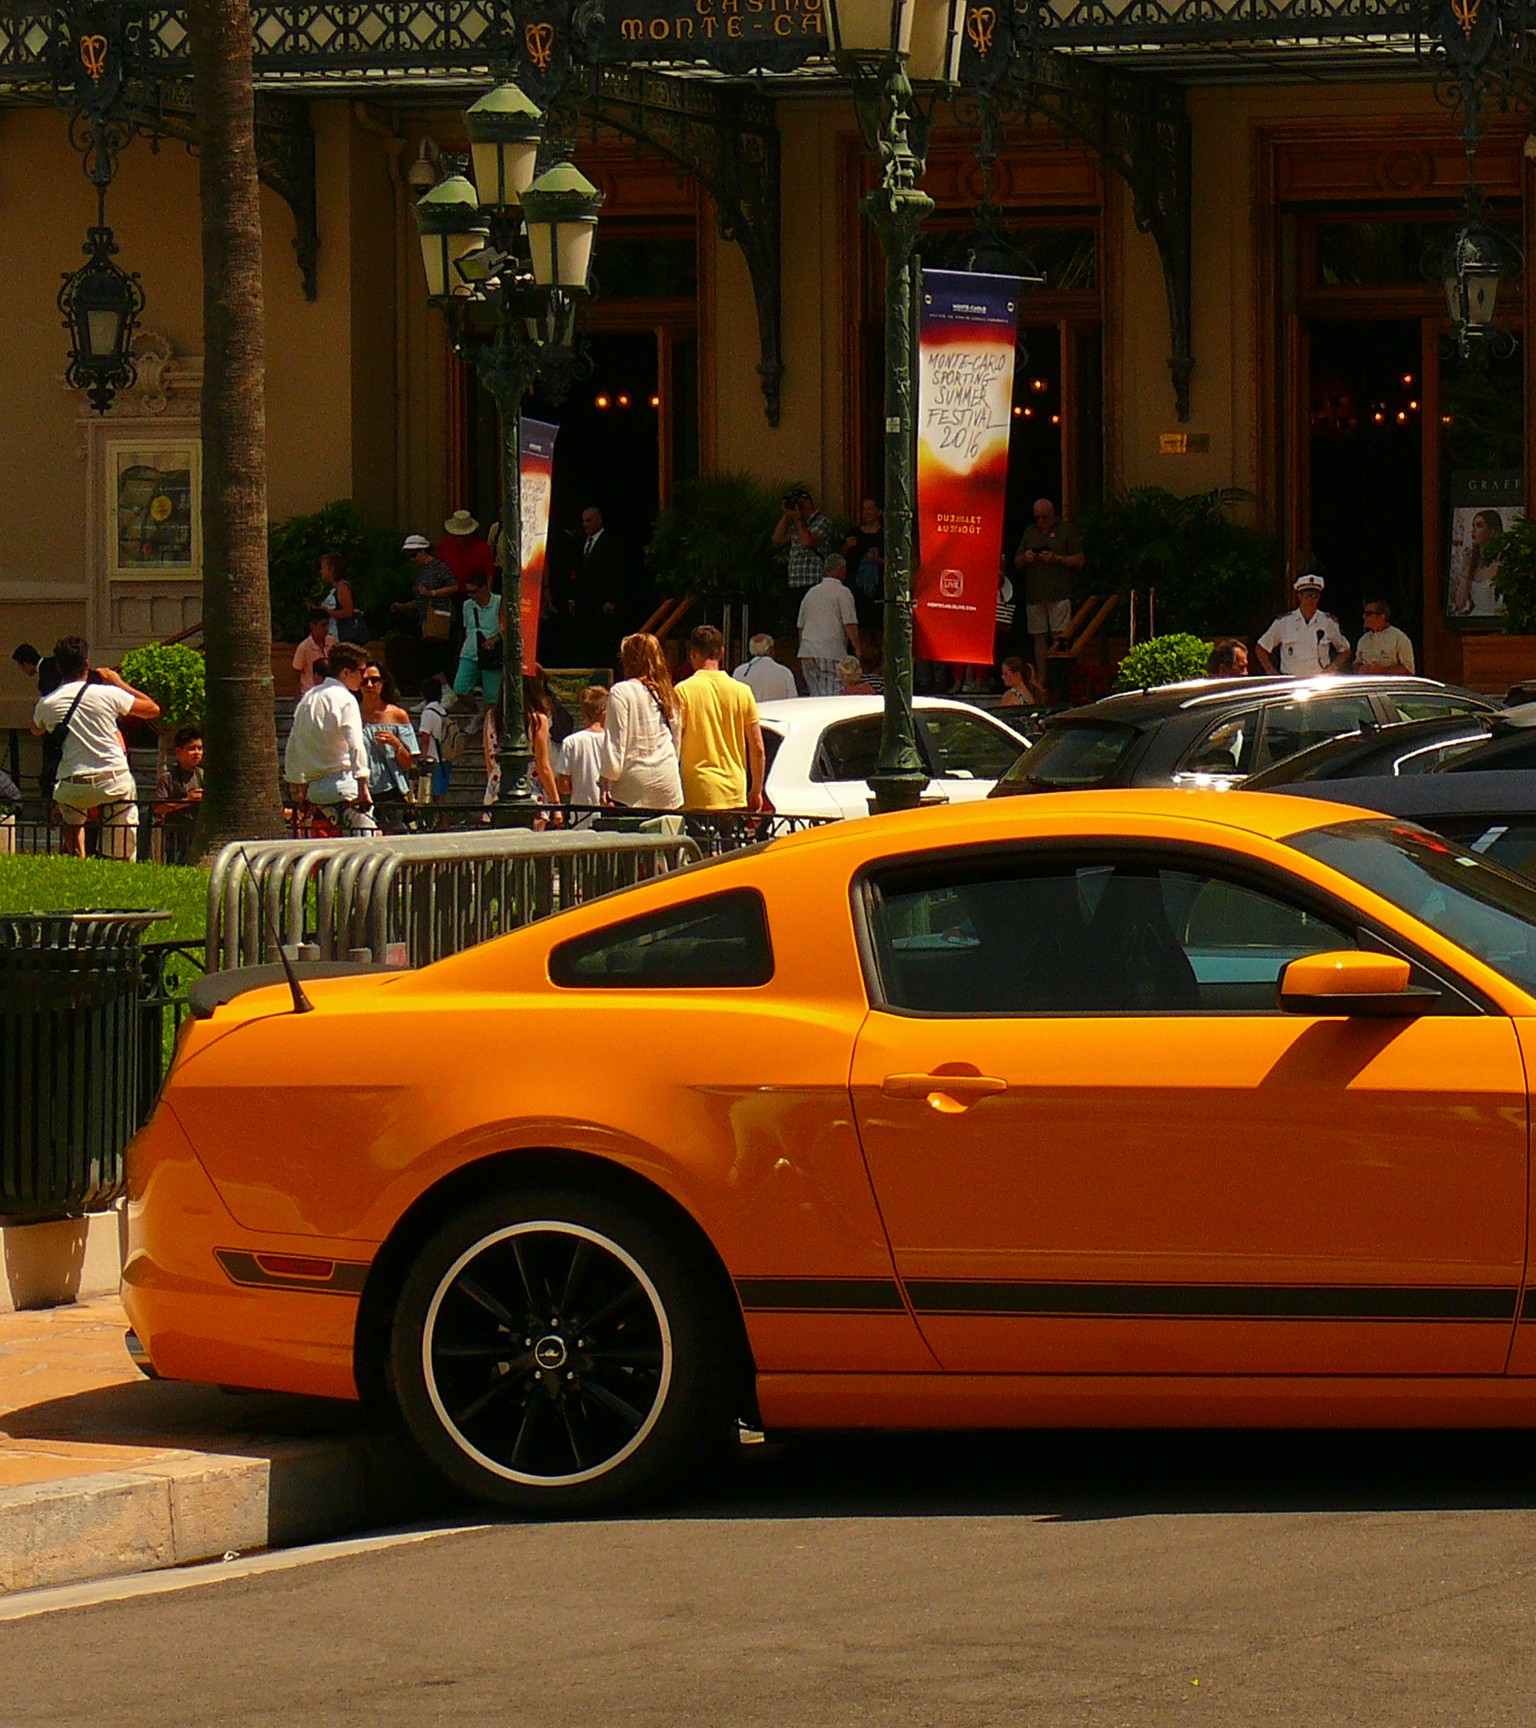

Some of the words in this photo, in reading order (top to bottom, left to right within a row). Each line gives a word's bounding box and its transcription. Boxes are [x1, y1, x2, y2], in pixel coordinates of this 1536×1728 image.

[620, 12, 823, 40] MONTE-CA
[928, 352, 1007, 374] MONTE-CARLO
[931, 370, 998, 387] SPORTING
[934, 385, 991, 409] SUMMER
[926, 408, 1009, 429] FESTIVAL
[939, 426, 982, 459] 2016
[1468, 479, 1522, 490] GRAFF
